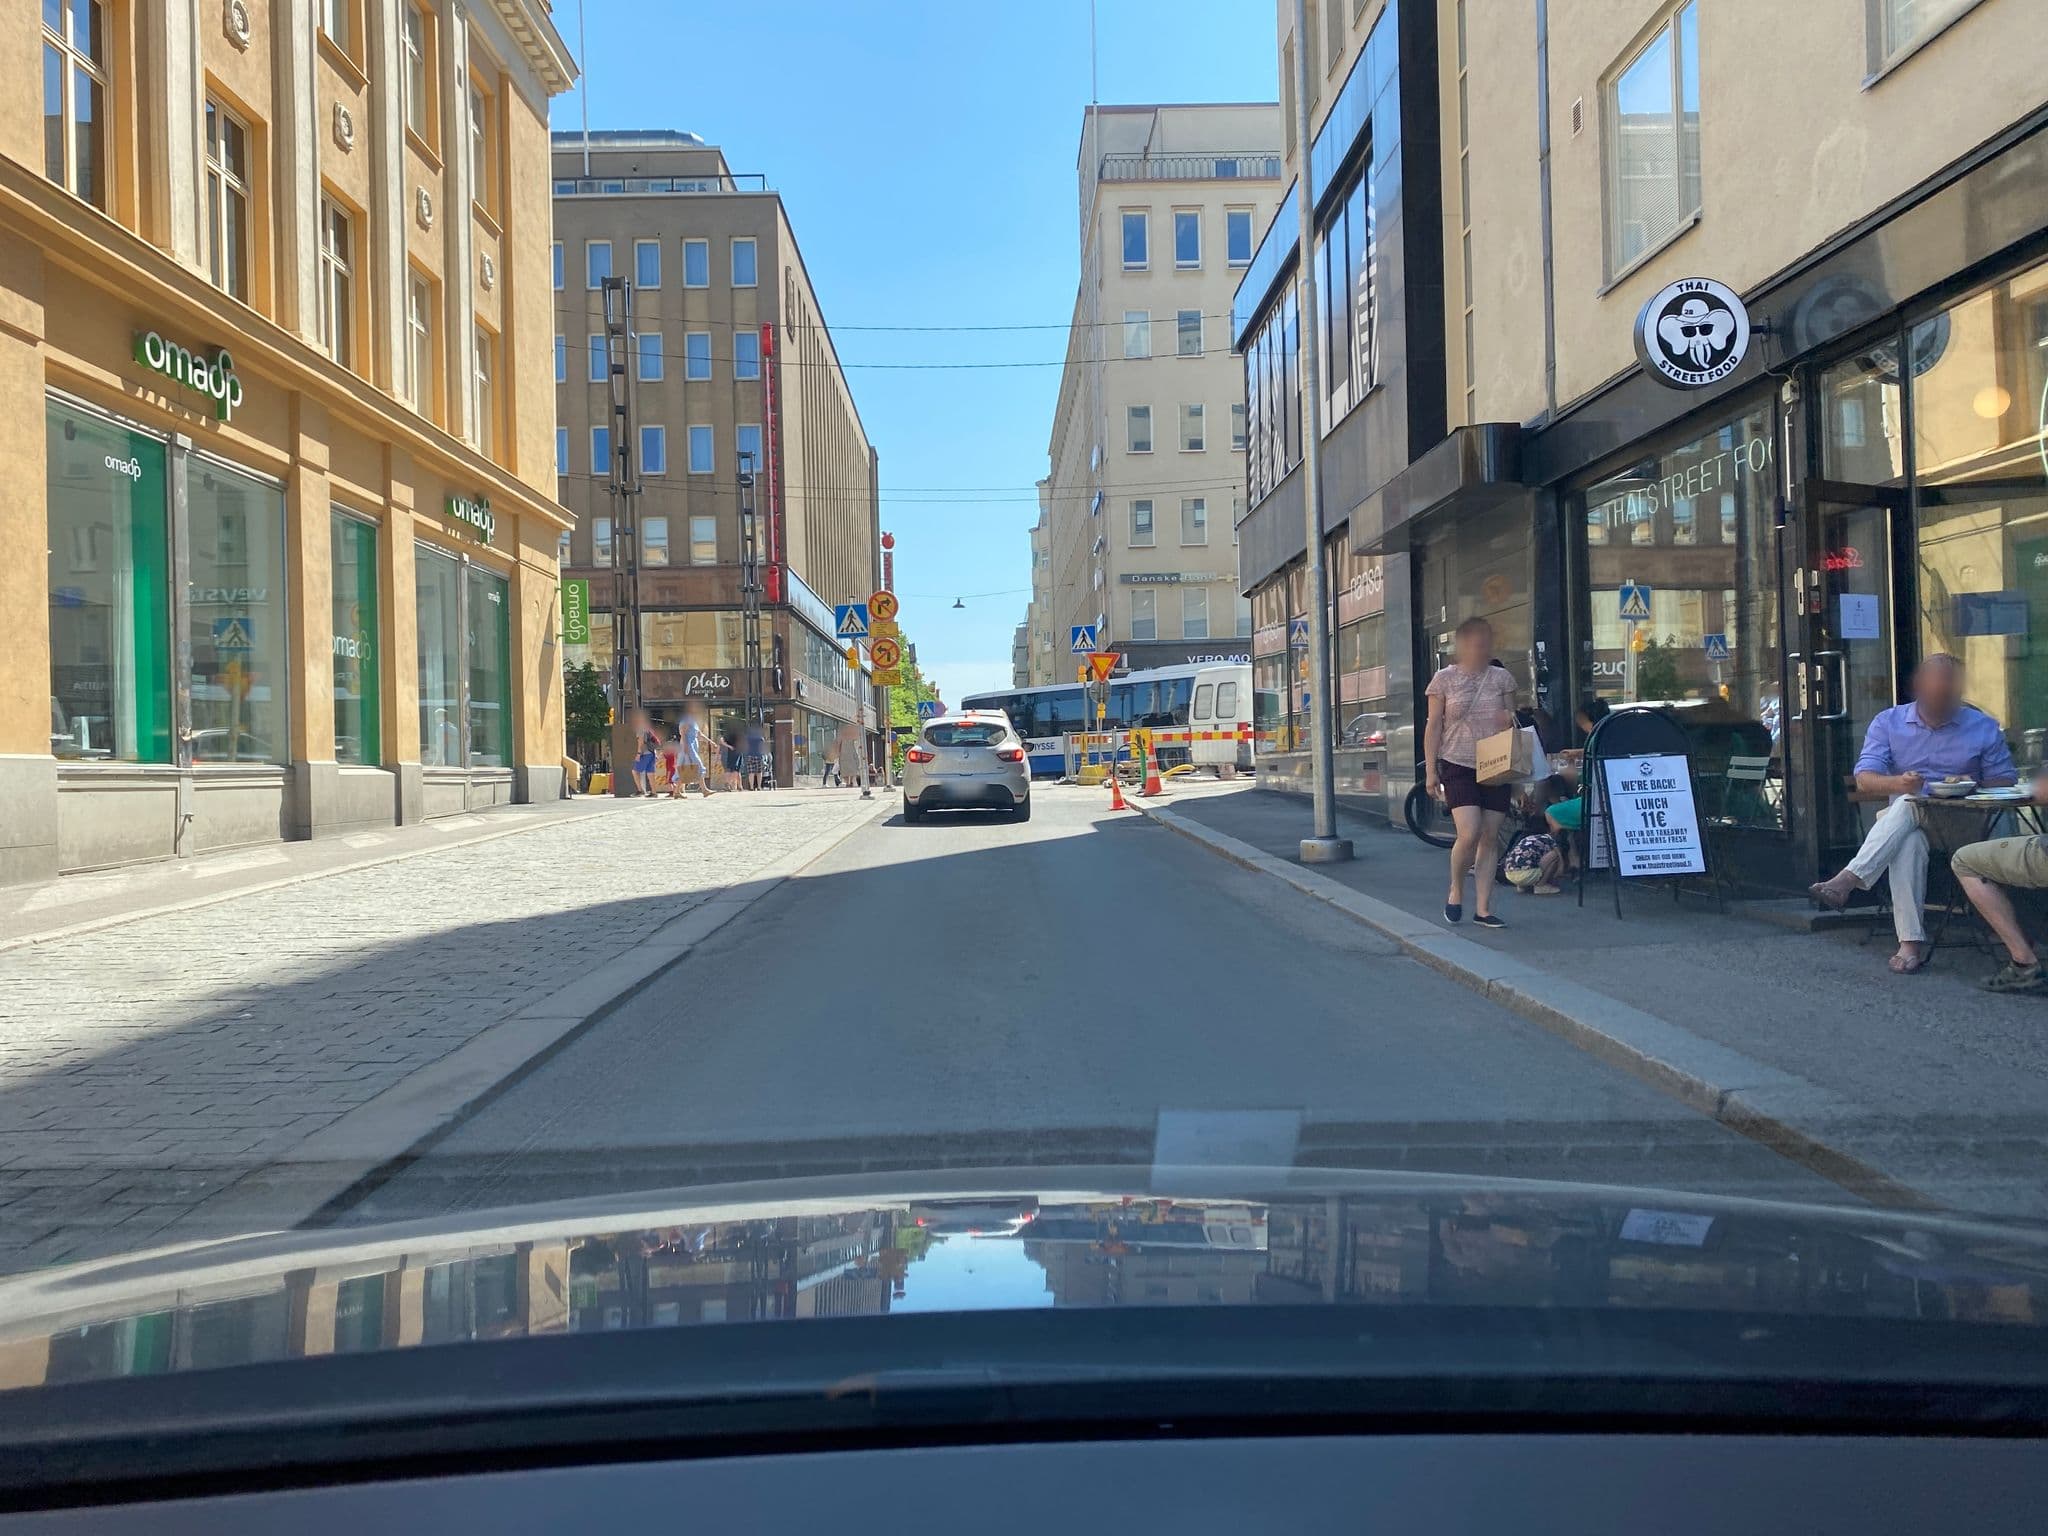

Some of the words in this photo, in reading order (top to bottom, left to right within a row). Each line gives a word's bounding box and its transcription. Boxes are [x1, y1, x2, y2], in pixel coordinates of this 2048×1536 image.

[1676, 281, 1710, 293] THAI
[1659, 360, 1705, 383] STREET
[1707, 355, 1738, 381] FOOD
[1646, 452, 1727, 514] STREET
[1734, 436, 1773, 481] FO
[1132, 574, 1178, 583] Danske
[1186, 654, 1224, 664] VERO
[1621, 780, 1649, 791] WE'RE
[1650, 778, 1677, 790] BACK!
[1635, 797, 1669, 810] LUNCH
[1641, 810, 1667, 828] 11€
[1625, 830, 1636, 838] EAT
[1629, 837, 1641, 845] IT'S
